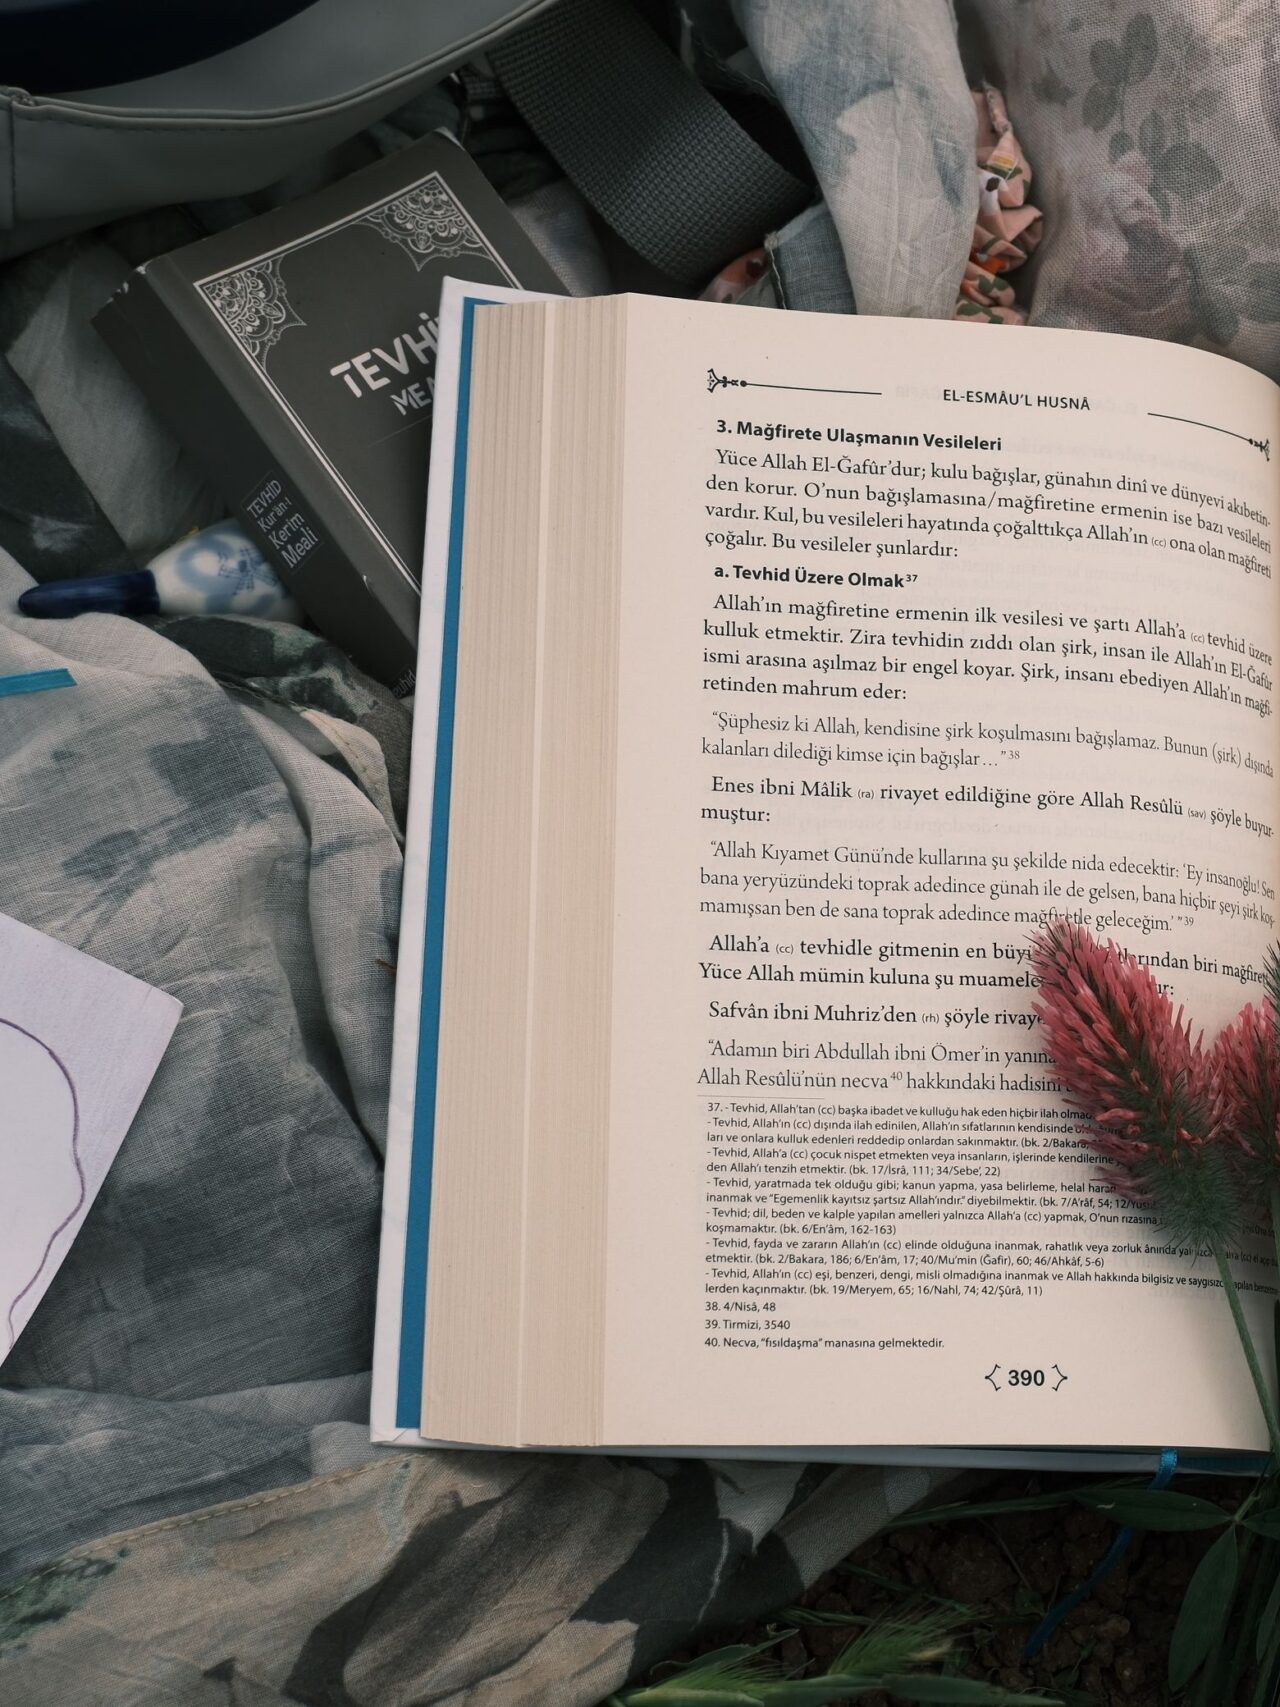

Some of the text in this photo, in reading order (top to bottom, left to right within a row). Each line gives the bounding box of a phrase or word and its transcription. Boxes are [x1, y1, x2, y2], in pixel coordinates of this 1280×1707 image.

[330, 312, 440, 399] TEVHİ
[1037, 395, 1091, 411] HUSNÂ
[716, 419, 1002, 452] 3. Mağfirete Ulaşmanın Vesileleri
[715, 448, 758, 467] Yüce
[760, 452, 808, 471] Allah
[930, 461, 969, 480] kulu
[971, 464, 1041, 487] bağışlar,
[1044, 471, 1113, 491] günahın
[1116, 474, 1148, 494] dinî
[1150, 483, 1168, 496] ve
[1170, 482, 1225, 510] dünyevi
[268, 513, 305, 550] Kerim
[704, 529, 958, 559] çoğalır. Bu vesileler şunlardır:
[281, 526, 319, 568] Meali
[713, 566, 730, 579] a.
[732, 564, 791, 583] Tevhid
[794, 566, 844, 586] Üzere
[701, 736, 769, 758] kalanları
[773, 740, 833, 767] dilediği
[836, 743, 884, 763] kimse
[887, 748, 916, 767] için
[711, 775, 755, 794] Enes
[759, 777, 796, 796] ibni
[800, 780, 853, 798] Mâlik
[880, 784, 940, 806] rivayet
[944, 784, 1032, 809] edildiğine
[1036, 790, 1075, 811] göre
[1079, 791, 1125, 810] Allah
[1129, 794, 1184, 816] Resûlü
[1210, 807, 1242, 829] şöyle
[700, 807, 771, 825] muştur:
[708, 1000, 769, 1020] Safvân
[773, 1002, 809, 1021] ibni
[813, 1003, 918, 1023] Muhriz’den
[944, 1006, 990, 1030] şöyle
[706, 1161, 728, 1173] den
[729, 1162, 762, 1173] Allah’ı
[763, 1163, 797, 1174] tenzih
[799, 1163, 847, 1175] etmektir.
[849, 1164, 869, 1176] (bk.
[912, 1165, 934, 1177] 111;
[984, 1166, 1001, 1178] 22)
[705, 1221, 777, 1235] koşmamaktır.
[779, 1223, 800, 1235] (bk.
[850, 1224, 897, 1236] 162-163)
[705, 1301, 777, 1313] 38. 4/Nisâ, 48
[704, 1319, 791, 1331] 39. Tirmizi, 3540
[704, 1337, 720, 1348] 40.
[723, 1337, 760, 1349] Necva,
[824, 1339, 876, 1349] manasına
[877, 1337, 944, 1351] gelmektedir.
[1007, 1369, 1046, 1387] 390
